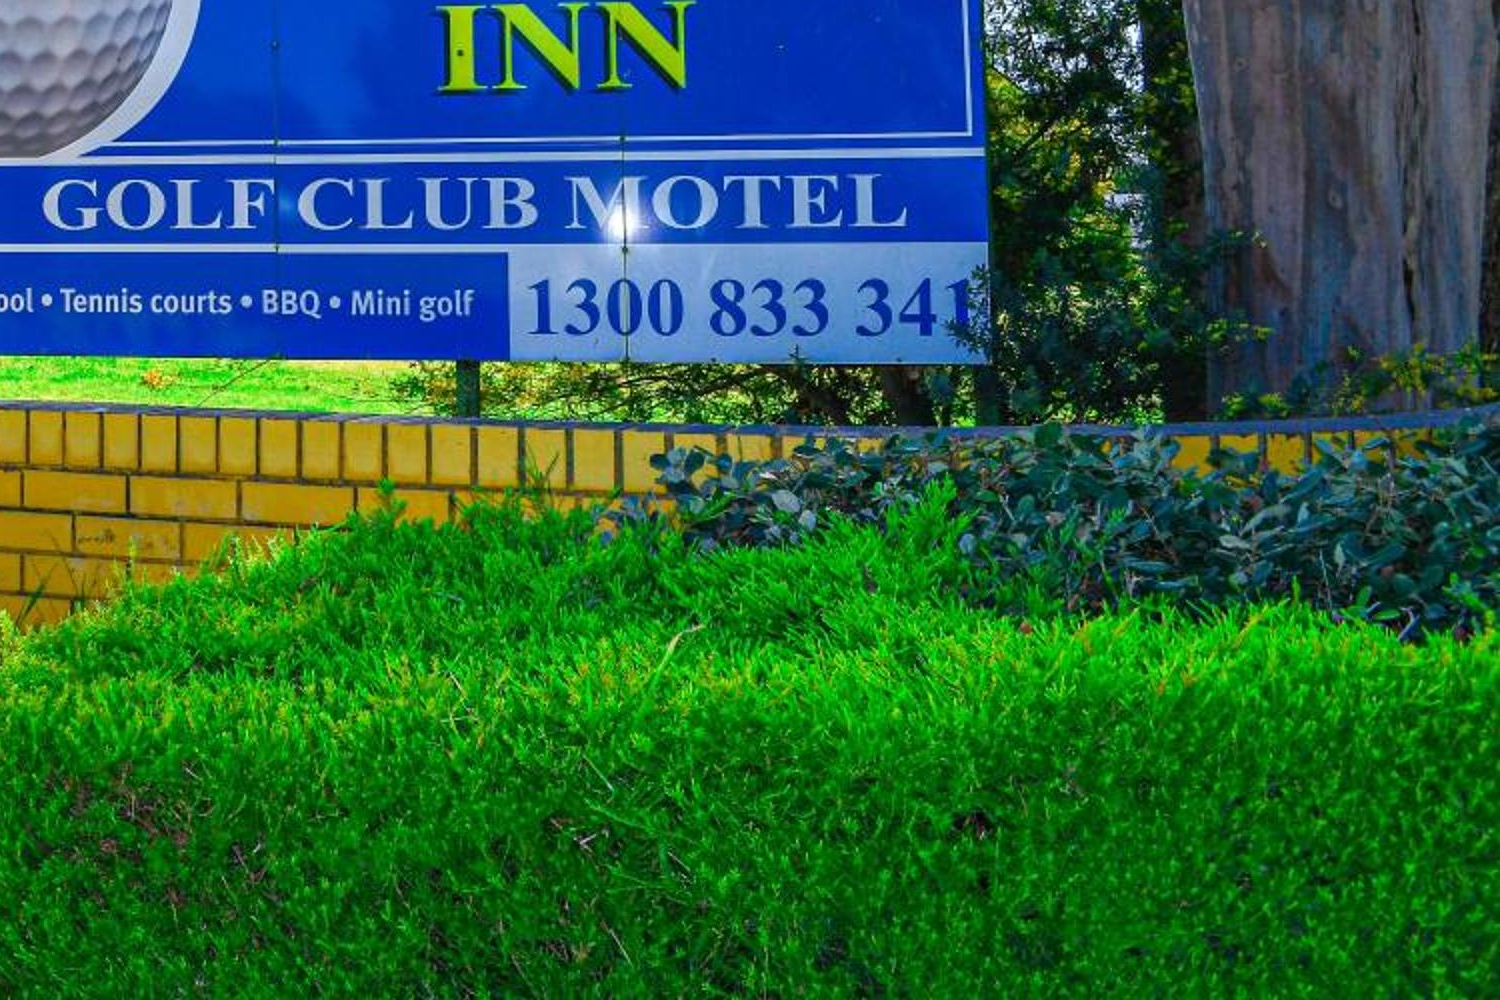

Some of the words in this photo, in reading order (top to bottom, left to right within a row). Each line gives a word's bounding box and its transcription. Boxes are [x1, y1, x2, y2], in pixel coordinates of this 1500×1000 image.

[435, 0, 696, 92] INN
[41, 178, 275, 231] GOLF
[297, 177, 538, 231] CLUB
[564, 173, 908, 229] MOTEL
[60, 288, 143, 315] Tennis
[150, 289, 233, 317] courts
[261, 290, 323, 320] BBQ
[351, 290, 411, 317] Mini
[419, 289, 476, 323] golf
[527, 277, 684, 336] 1300
[709, 277, 829, 337] 833
[855, 277, 972, 337] 341
